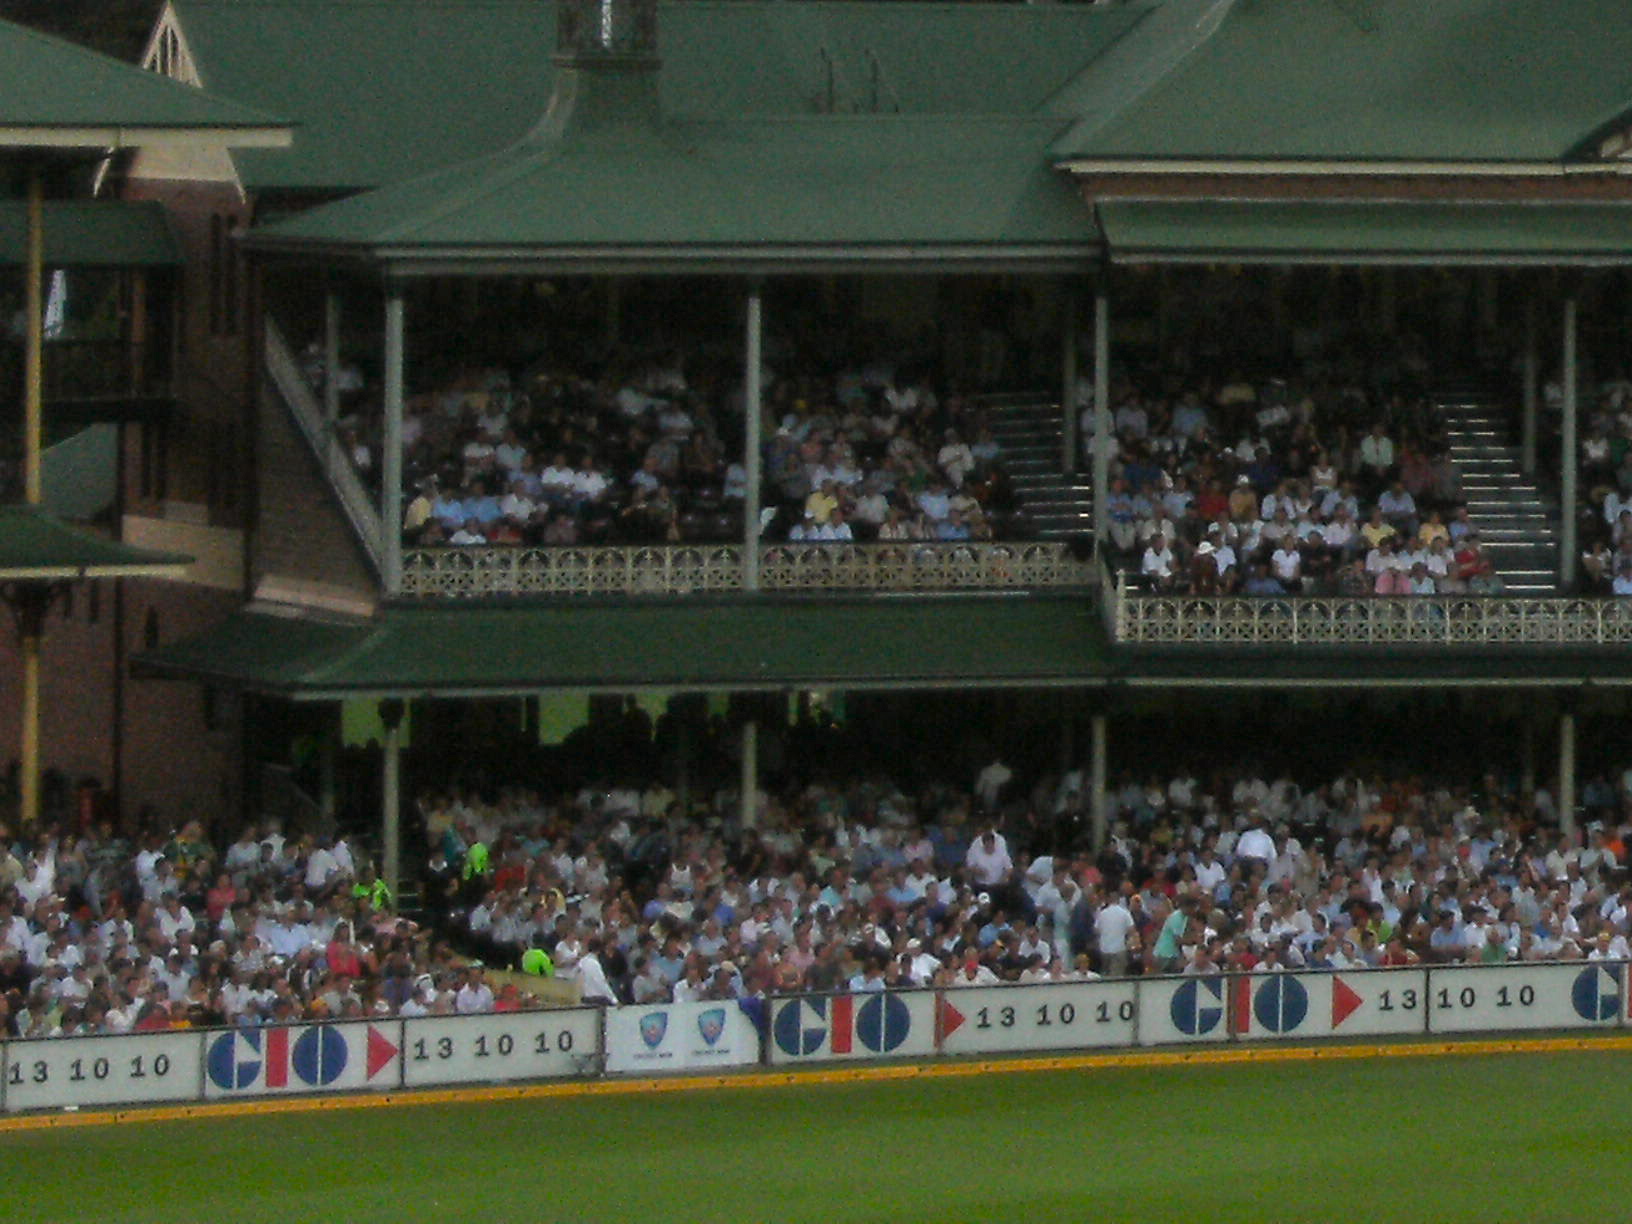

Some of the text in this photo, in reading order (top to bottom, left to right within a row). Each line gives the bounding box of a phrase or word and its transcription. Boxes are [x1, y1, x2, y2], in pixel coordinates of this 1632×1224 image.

[1169, 973, 1309, 1036] GIO
[1379, 985, 1535, 1011] 13 10 10
[771, 992, 912, 1057] GIO
[977, 1000, 1134, 1029] 13 10 10
[207, 1026, 348, 1091] GIO
[414, 1031, 573, 1060] 13 10 10
[9, 1054, 170, 1085] 13 10 10
